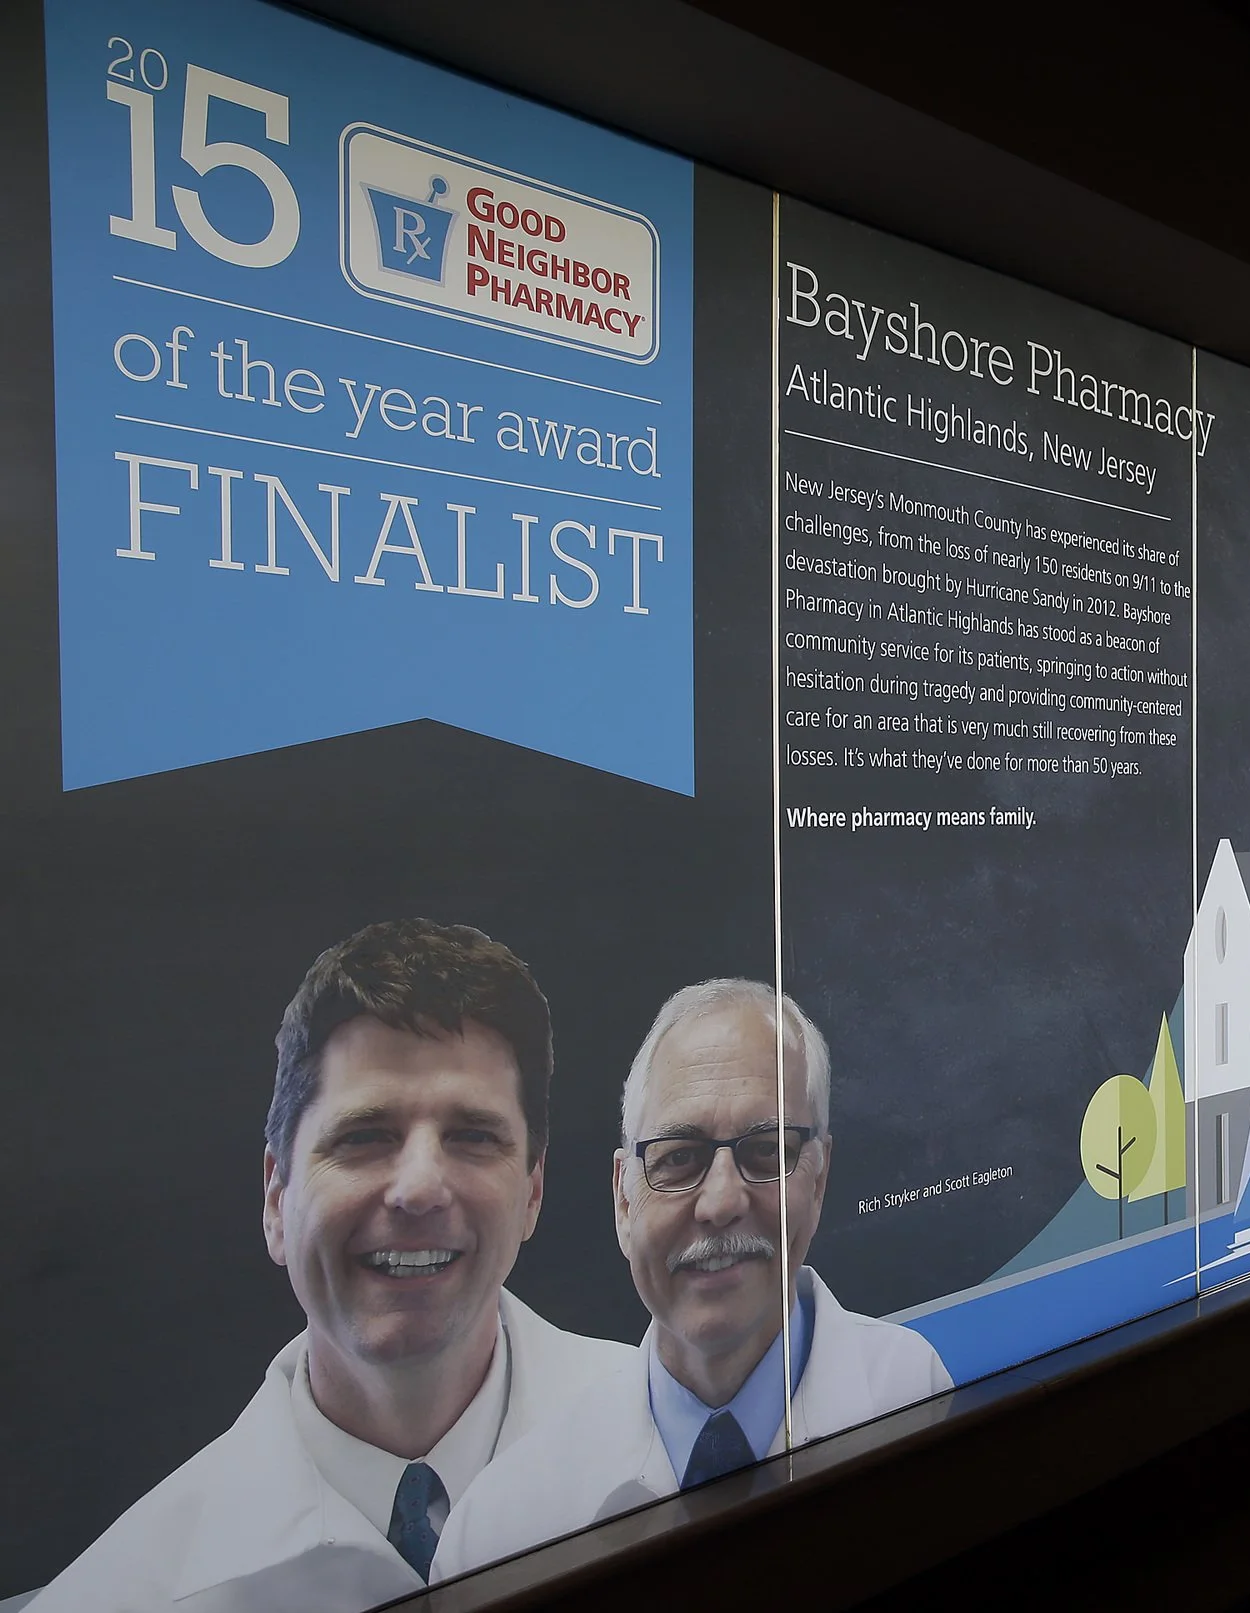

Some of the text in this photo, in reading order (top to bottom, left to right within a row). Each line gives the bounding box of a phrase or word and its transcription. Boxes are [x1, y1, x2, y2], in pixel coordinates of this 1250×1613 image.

[107, 36, 169, 91] 20
[107, 62, 301, 268] 15
[466, 186, 566, 243] GOOD
[467, 223, 631, 302] NEIGHBOR
[786, 261, 1215, 457] Bayshore Pharmacy
[113, 325, 661, 478] of the year award
[785, 364, 1157, 495] Atlantic Highlands, New Jersey
[114, 451, 663, 615] FINALIST
[786, 471, 823, 496] New
[890, 492, 969, 525] Monmouth
[975, 510, 1021, 539] County
[1026, 519, 1046, 540] has
[1051, 530, 1119, 554] experienced
[1123, 540, 1134, 557] its
[1138, 544, 1165, 564] share
[1169, 551, 1179, 566] of
[786, 511, 1189, 598] challenges, from the loss of nearly 150 residents on 9/11 to the
[786, 549, 1170, 625] devastation brought by Hurricane Sandy in 2012. Bayshore
[787, 589, 1160, 653] Pharmacy in Atlantic Highlands has stood as a beacon of
[786, 633, 1187, 687] community service for its patients, springing to action without
[787, 666, 1181, 716] hesitation during tragedy and providing community-centered
[787, 707, 1176, 746] care for an area that is very much still recovering from these
[788, 744, 837, 766] losses.
[869, 748, 907, 767] what
[967, 751, 1000, 770] done
[1005, 752, 1023, 770] for
[1028, 759, 1058, 772] more
[1063, 755, 1088, 773] than
[1093, 757, 1107, 773] 50
[1111, 762, 1141, 778] years.
[787, 807, 1036, 831] Where pharmacy means family.
[859, 1167, 1012, 1214] Rich Stryker and Scott Eagleton
